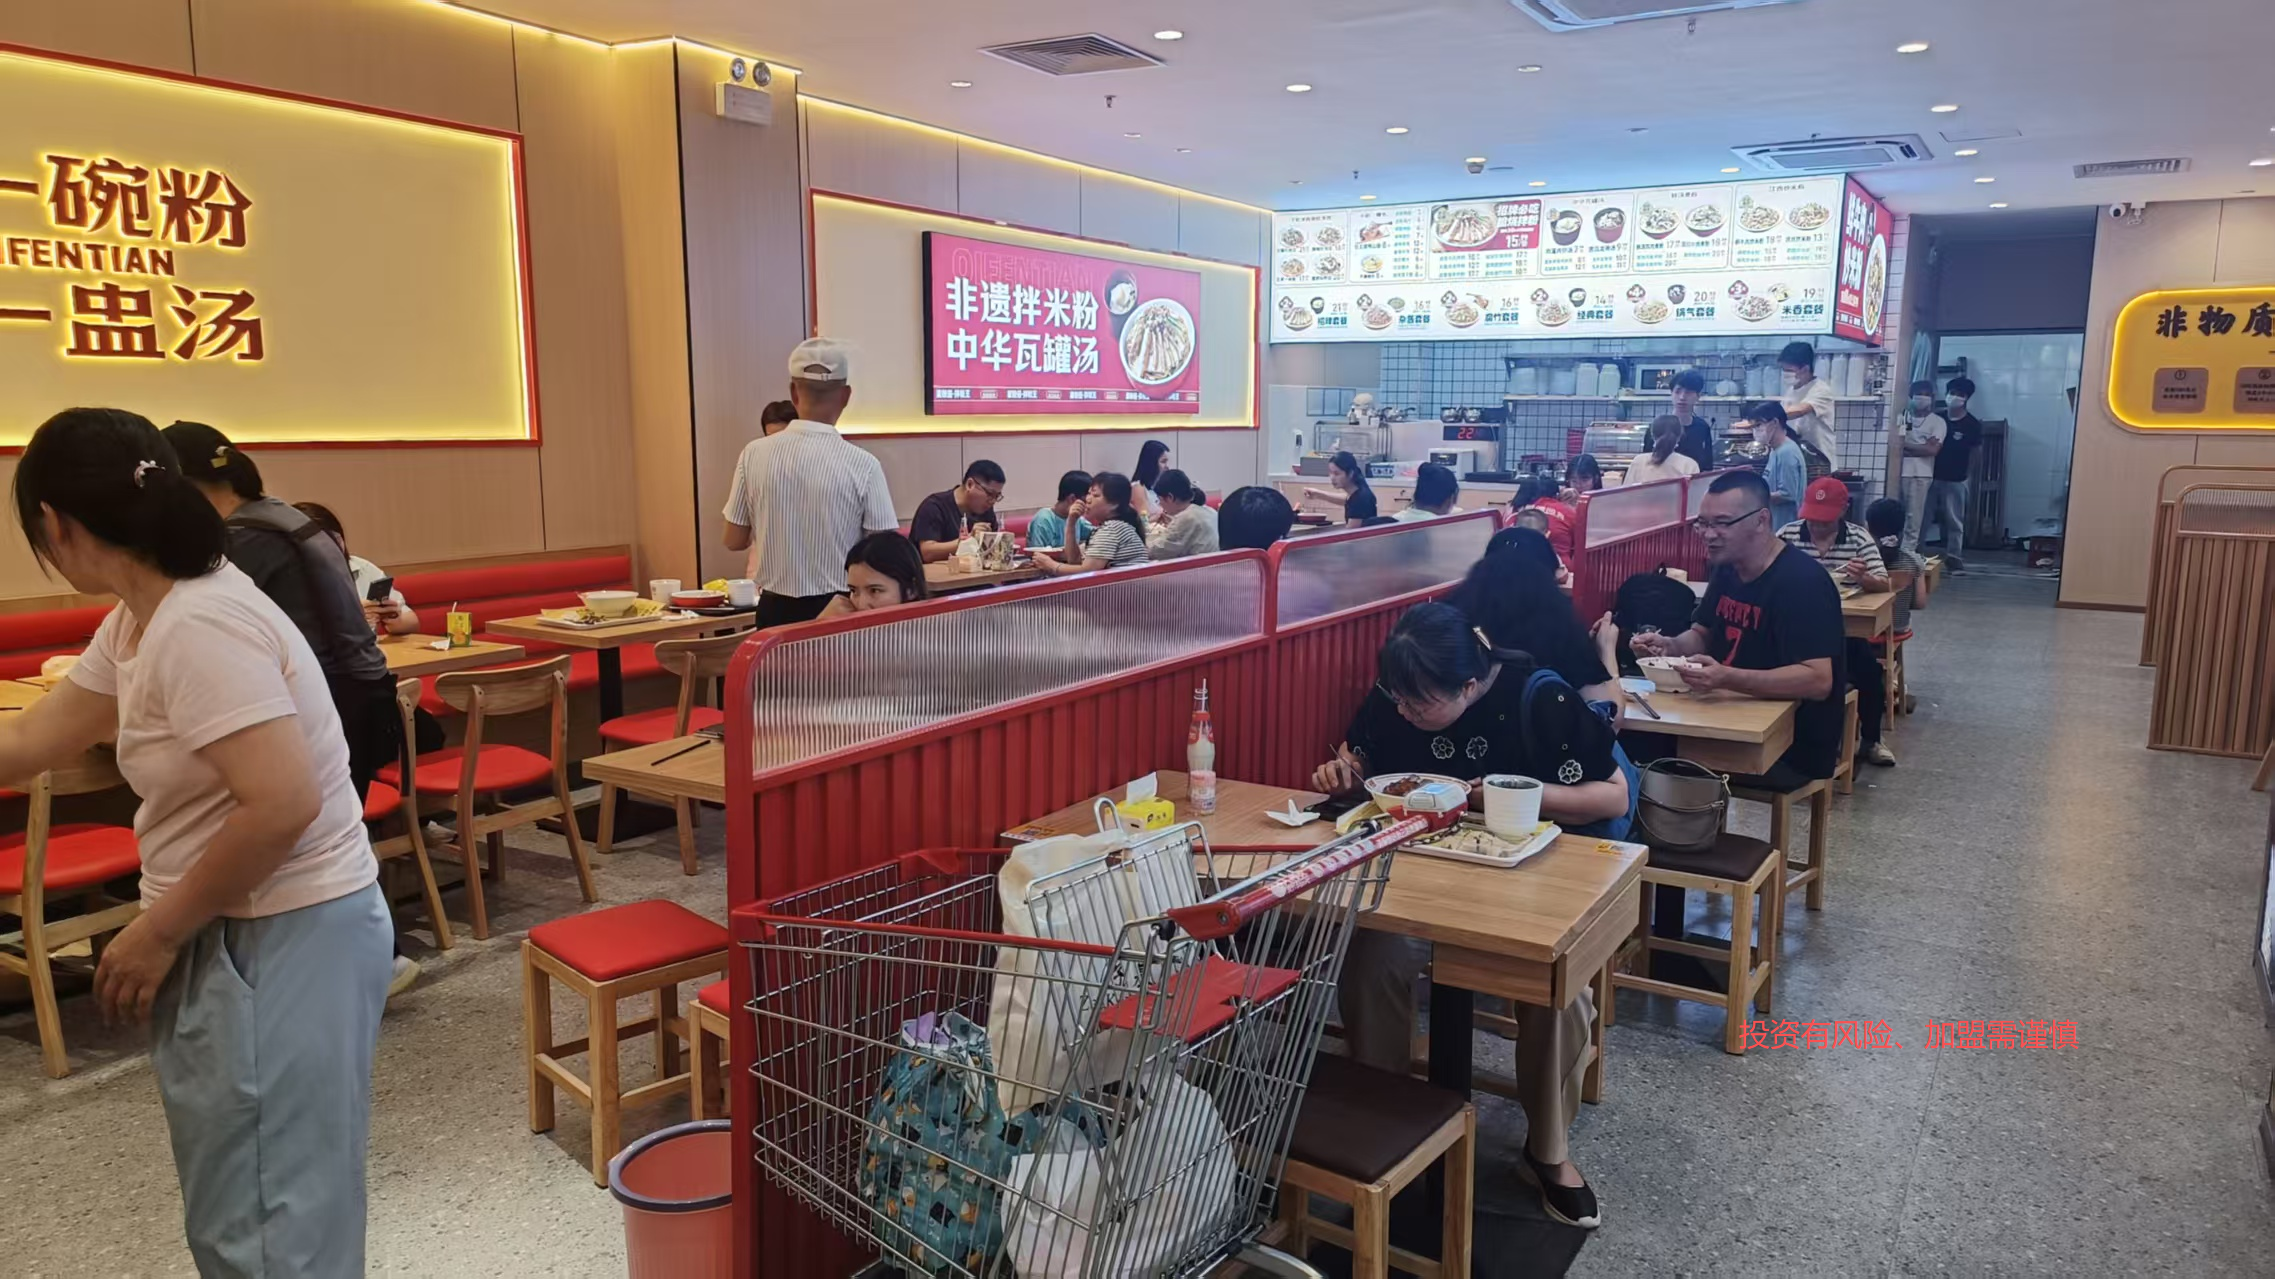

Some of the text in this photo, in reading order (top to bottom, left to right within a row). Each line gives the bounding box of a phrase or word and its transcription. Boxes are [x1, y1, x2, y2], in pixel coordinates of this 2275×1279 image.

[1694, 291, 1708, 301] 20
[1803, 288, 1815, 299] 19
[945, 276, 1099, 331] 非遗拌米粉
[1502, 298, 1512, 308] 16
[1595, 295, 1607, 305] 14
[2155, 302, 2275, 338] 非物质
[946, 327, 1099, 375] 中华瓦罐汤
[1457, 427, 1474, 440] 22
